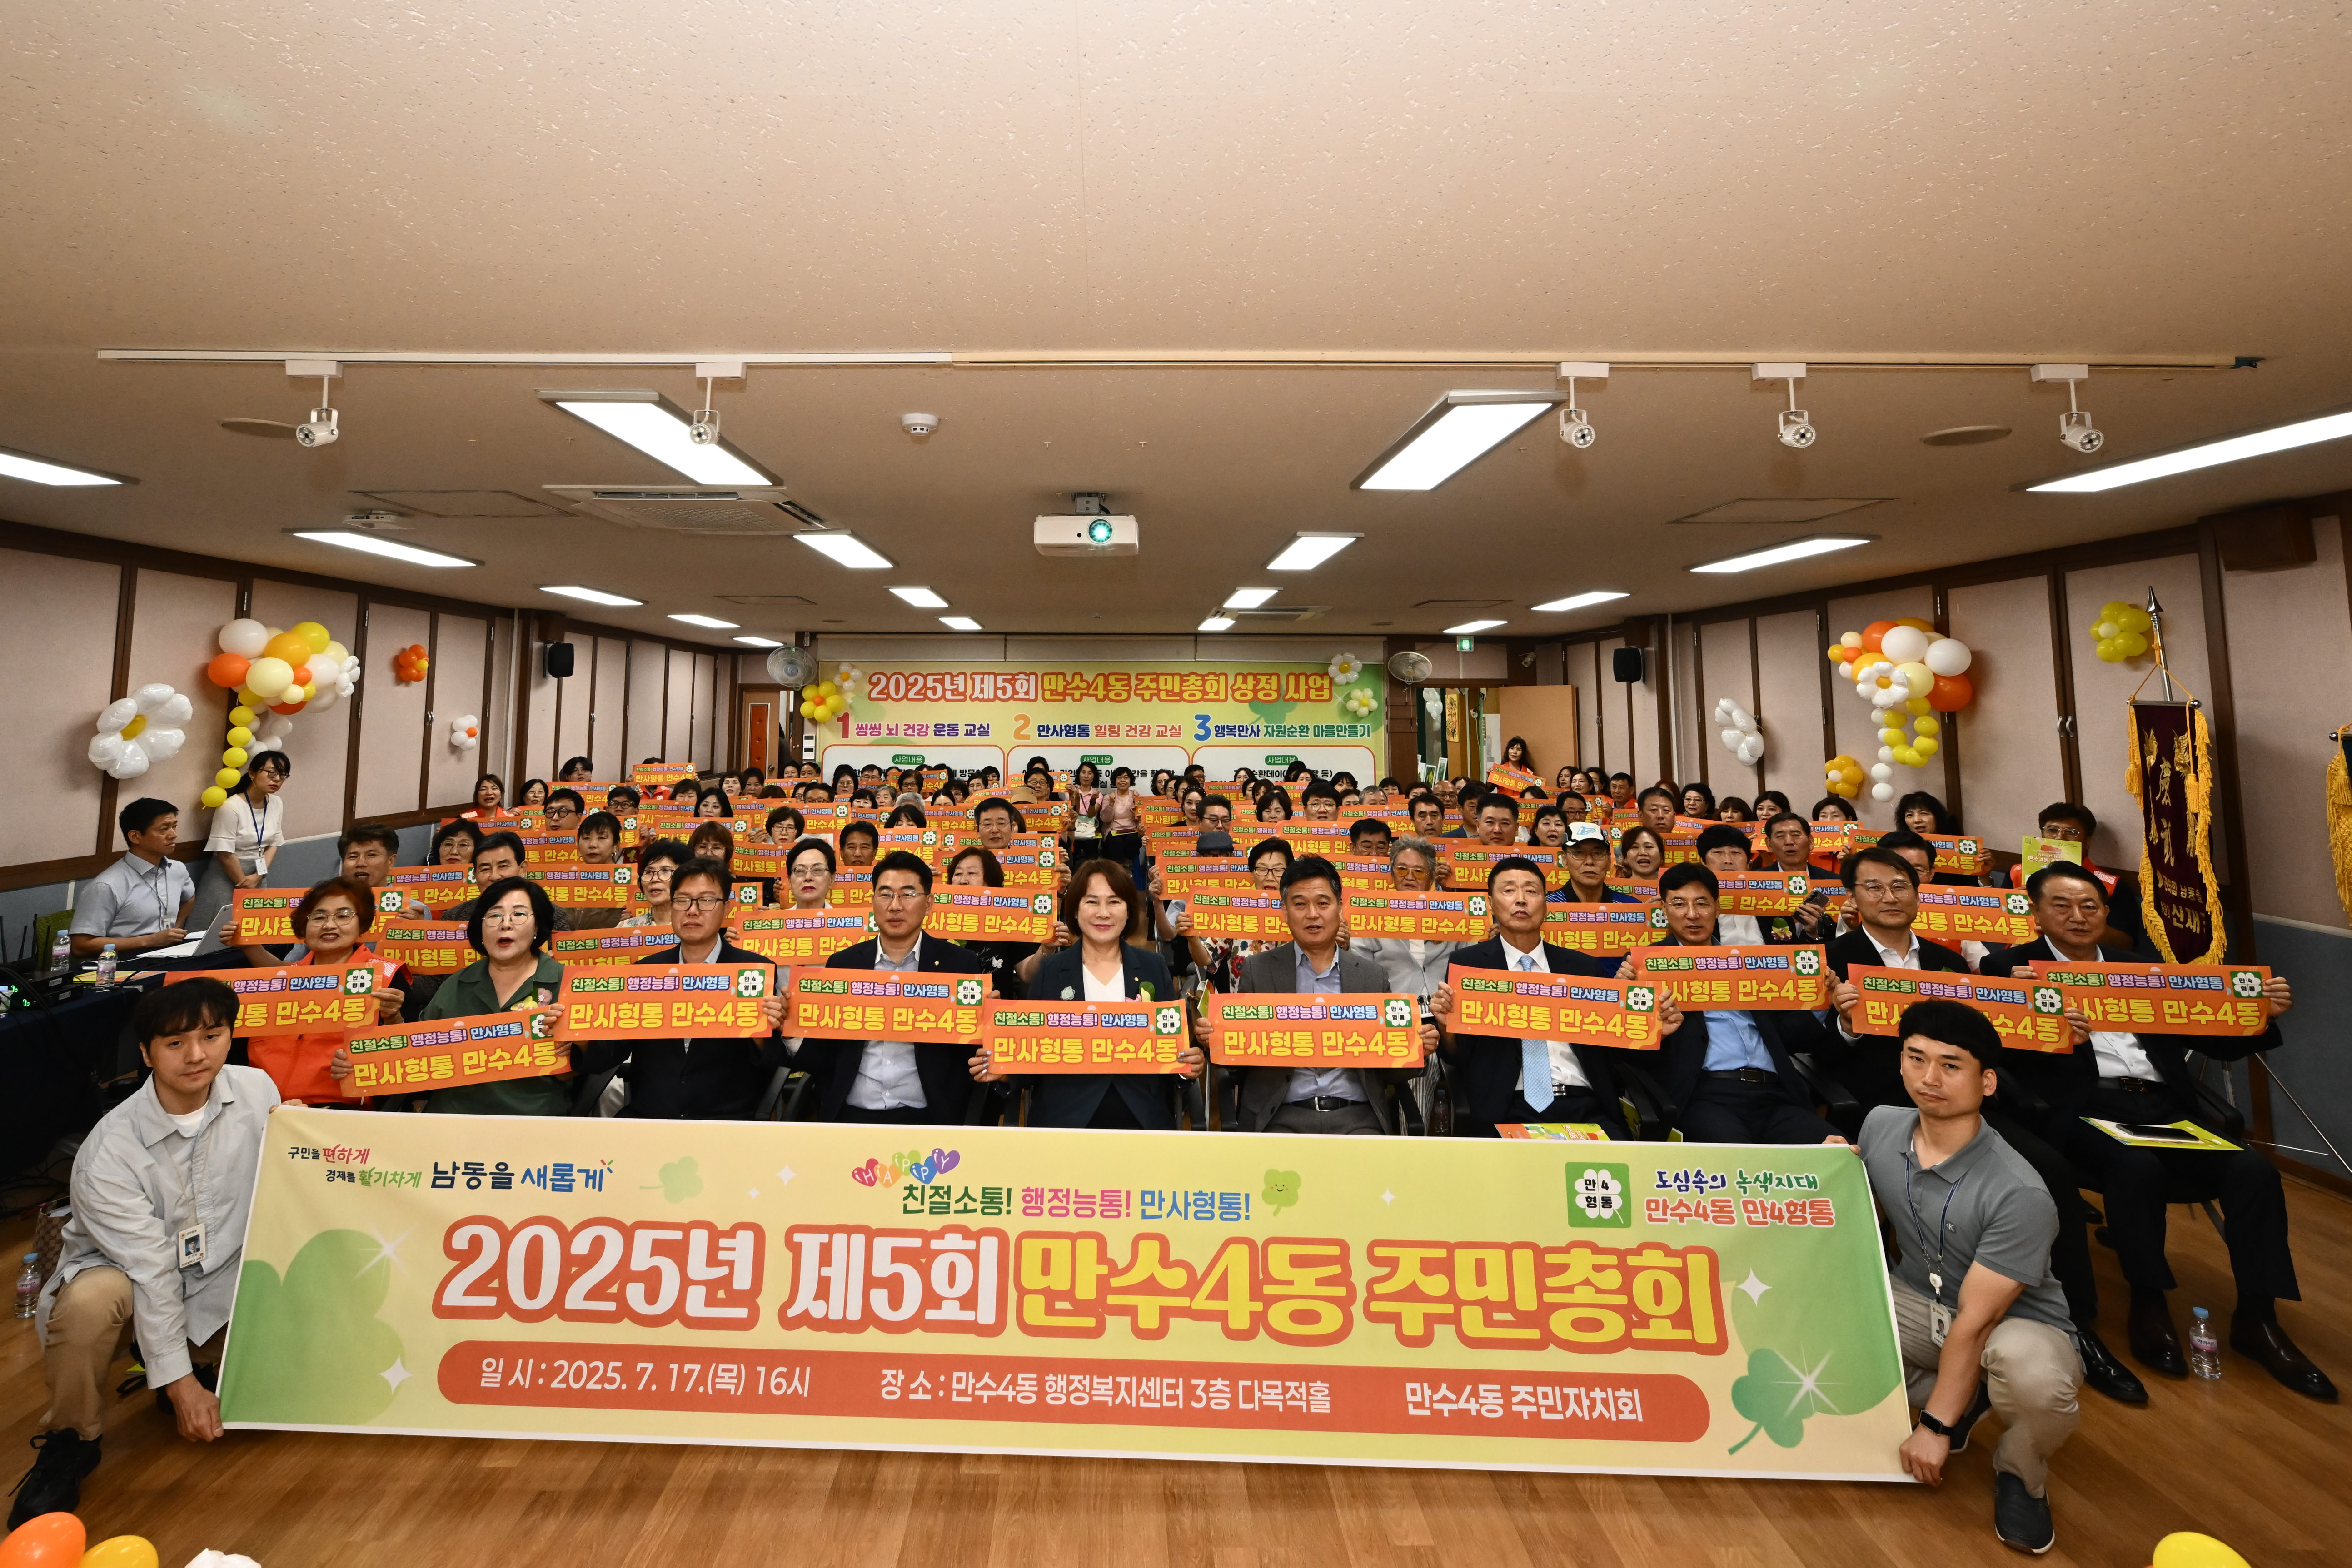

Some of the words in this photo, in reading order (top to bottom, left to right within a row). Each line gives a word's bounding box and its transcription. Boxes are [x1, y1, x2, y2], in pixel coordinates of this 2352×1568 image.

[870, 673, 965, 700] 2025년
[971, 673, 1036, 700] 제5회
[1044, 674, 1130, 701] 만수4동
[1136, 674, 1227, 701] 주민총회
[1232, 674, 1278, 702] 상정
[1285, 674, 1331, 702] 사업
[836, 712, 850, 739] 1
[855, 723, 882, 737] 씽씽
[885, 723, 899, 737] 뇌
[903, 723, 930, 737] 건강
[933, 723, 960, 737] 운동
[963, 723, 990, 737] 교실
[1013, 714, 1031, 741] 2
[1037, 724, 1090, 738] 만사형통
[1094, 724, 1121, 738] 힐링
[1125, 724, 1151, 738] 건강
[1155, 724, 1182, 738] 교실
[1193, 714, 1212, 742] 3
[1214, 724, 1261, 738] 행복만사
[1263, 724, 1310, 738] 자원순환
[1313, 724, 1370, 738] 마을만들기
[894, 755, 923, 764] 사업내용
[1082, 756, 1111, 764] 사업내용
[807, 818, 847, 830] 만수4동
[1026, 817, 1061, 828] 만수4동
[1282, 826, 1310, 835] 친절소통!
[1311, 827, 1339, 836] 행정능통!
[1006, 855, 1035, 866] 만사형통
[1162, 849, 1189, 858] 친절소통!
[1454, 851, 1487, 861] 친절소통!
[733, 858, 777, 873] 만사형통
[1166, 863, 1197, 874] 친절소통!
[1198, 863, 1229, 873] 행정능통!
[395, 873, 430, 884] 행정능통!
[431, 871, 463, 881] 만사형통
[546, 871, 578, 881] 행정능통!
[580, 871, 610, 881] 만사형통
[1748, 879, 1783, 891] 만사형통
[243, 897, 287, 909] 친절소통!
[573, 886, 628, 902] 만수4동
[953, 893, 992, 907] 행정능통!
[993, 896, 1029, 908] 만사형통
[1193, 893, 1230, 906] 친절소통!
[1231, 896, 1270, 909] 행정능통!
[1350, 896, 1388, 908] 친절소통!
[1389, 898, 1427, 910] 행정능통!
[1429, 900, 1464, 911] 만사형통
[1958, 895, 2001, 908] 만사형통
[742, 918, 784, 931] 친절소통!
[785, 917, 825, 929] 행정능통!
[827, 916, 863, 928] 만사형통
[984, 915, 1049, 936] 만수4동
[1192, 911, 1260, 934] 만사형통
[1350, 913, 1417, 934] 만사형통
[1421, 916, 1485, 937] 만수4동
[1569, 911, 1608, 924] 행정능통!
[1609, 911, 1646, 923] 만사형통
[1953, 913, 2030, 938] 만수4동
[386, 929, 424, 941] 친절소통!
[556, 939, 598, 952] 친절소통!
[600, 936, 643, 949] 행정능통!
[742, 937, 814, 957] 만사형통
[1645, 956, 1694, 971] 친절소통!
[1695, 956, 1743, 971] 행정능통!
[1744, 955, 1789, 970] 만사형통
[234, 976, 287, 994] 행정능통!
[289, 975, 339, 991] 만사형통
[571, 977, 625, 993] 친절소통!
[627, 976, 680, 992] 행정능통!
[681, 975, 731, 991] 만사형통
[799, 978, 848, 994] 친절소통!
[850, 981, 901, 996] 행정능통!
[902, 983, 950, 998] 만사형통
[1461, 976, 1514, 994] 친절소통!
[1515, 981, 1568, 998] 행정능통!
[1570, 985, 1619, 1003] 만사형통
[1738, 978, 1818, 1003] 만수4동
[1863, 976, 1916, 994] 친절소통!
[1918, 981, 1973, 1000] 행정능통!
[1975, 986, 2027, 1005] 만사형통
[2107, 973, 2167, 990] 행정능통!
[2168, 975, 2224, 991] 만사형통
[275, 998, 366, 1027] 만수4동
[568, 1001, 664, 1030] 만사형통
[671, 1001, 759, 1028] 만수4동
[798, 1003, 886, 1031] 만사형통
[892, 1007, 978, 1034] 만수4동
[993, 1011, 1044, 1027] 친절소통!
[1046, 1012, 1099, 1028] 행정능통!
[1100, 1013, 1149, 1028] 만사형통
[1221, 1005, 1274, 1020] 친절소통!
[1276, 1005, 1328, 1020] 행정능통!
[1330, 1005, 1379, 1020] 만사형통
[1461, 1000, 1552, 1031] 만사형통
[1559, 1009, 1649, 1040] 만수4동
[2163, 999, 2261, 1026] 만수4동
[350, 1035, 408, 1054] 친절소통!
[410, 1028, 468, 1047] 행정능통!
[470, 1022, 523, 1040] 만사형통
[1223, 1030, 1315, 1057] 만사형통
[1322, 1031, 1410, 1058] 만수4동
[993, 1037, 1085, 1064] 만사형통
[1091, 1038, 1178, 1063] 만수4동
[353, 1054, 455, 1087] 만사형통
[462, 1040, 558, 1076] 만수4동
[287, 1147, 320, 1160] 구민을
[322, 1144, 370, 1165] 편하게
[325, 1169, 356, 1184] 경제를
[358, 1166, 422, 1189] 활기차게
[430, 1161, 515, 1190] 남동을
[520, 1162, 605, 1193] 새롭게
[1584, 1179, 1596, 1191] 만
[1655, 1168, 1727, 1194] 도심속의
[1735, 1170, 1819, 1195] 녹색지대
[902, 1184, 1012, 1216] 친절소통!
[1022, 1187, 1131, 1219] 행정능통!
[1140, 1190, 1251, 1222] 만사형통!
[1585, 1196, 1597, 1209] 형
[1600, 1196, 1613, 1209] 통
[1646, 1198, 1736, 1225] 만수4동
[1741, 1199, 1835, 1226] 만4형통
[442, 1225, 754, 1318] 2025년
[787, 1233, 998, 1324] 제5회
[1021, 1238, 1347, 1335] 만수4동
[1369, 1247, 1718, 1344] 주민총회
[551, 1360, 628, 1390] 2025.
[636, 1363, 657, 1391] 7.
[669, 1363, 746, 1396] 17.(목)
[756, 1366, 811, 1398] 16시
[952, 1371, 1039, 1404] 만수4동
[1044, 1373, 1183, 1410] 행정복지센터
[1191, 1379, 1231, 1410] 3층
[1238, 1379, 1331, 1414] 다목적홀
[1405, 1382, 1504, 1418] 만수4동
[1510, 1385, 1644, 1422] 주민자치회
